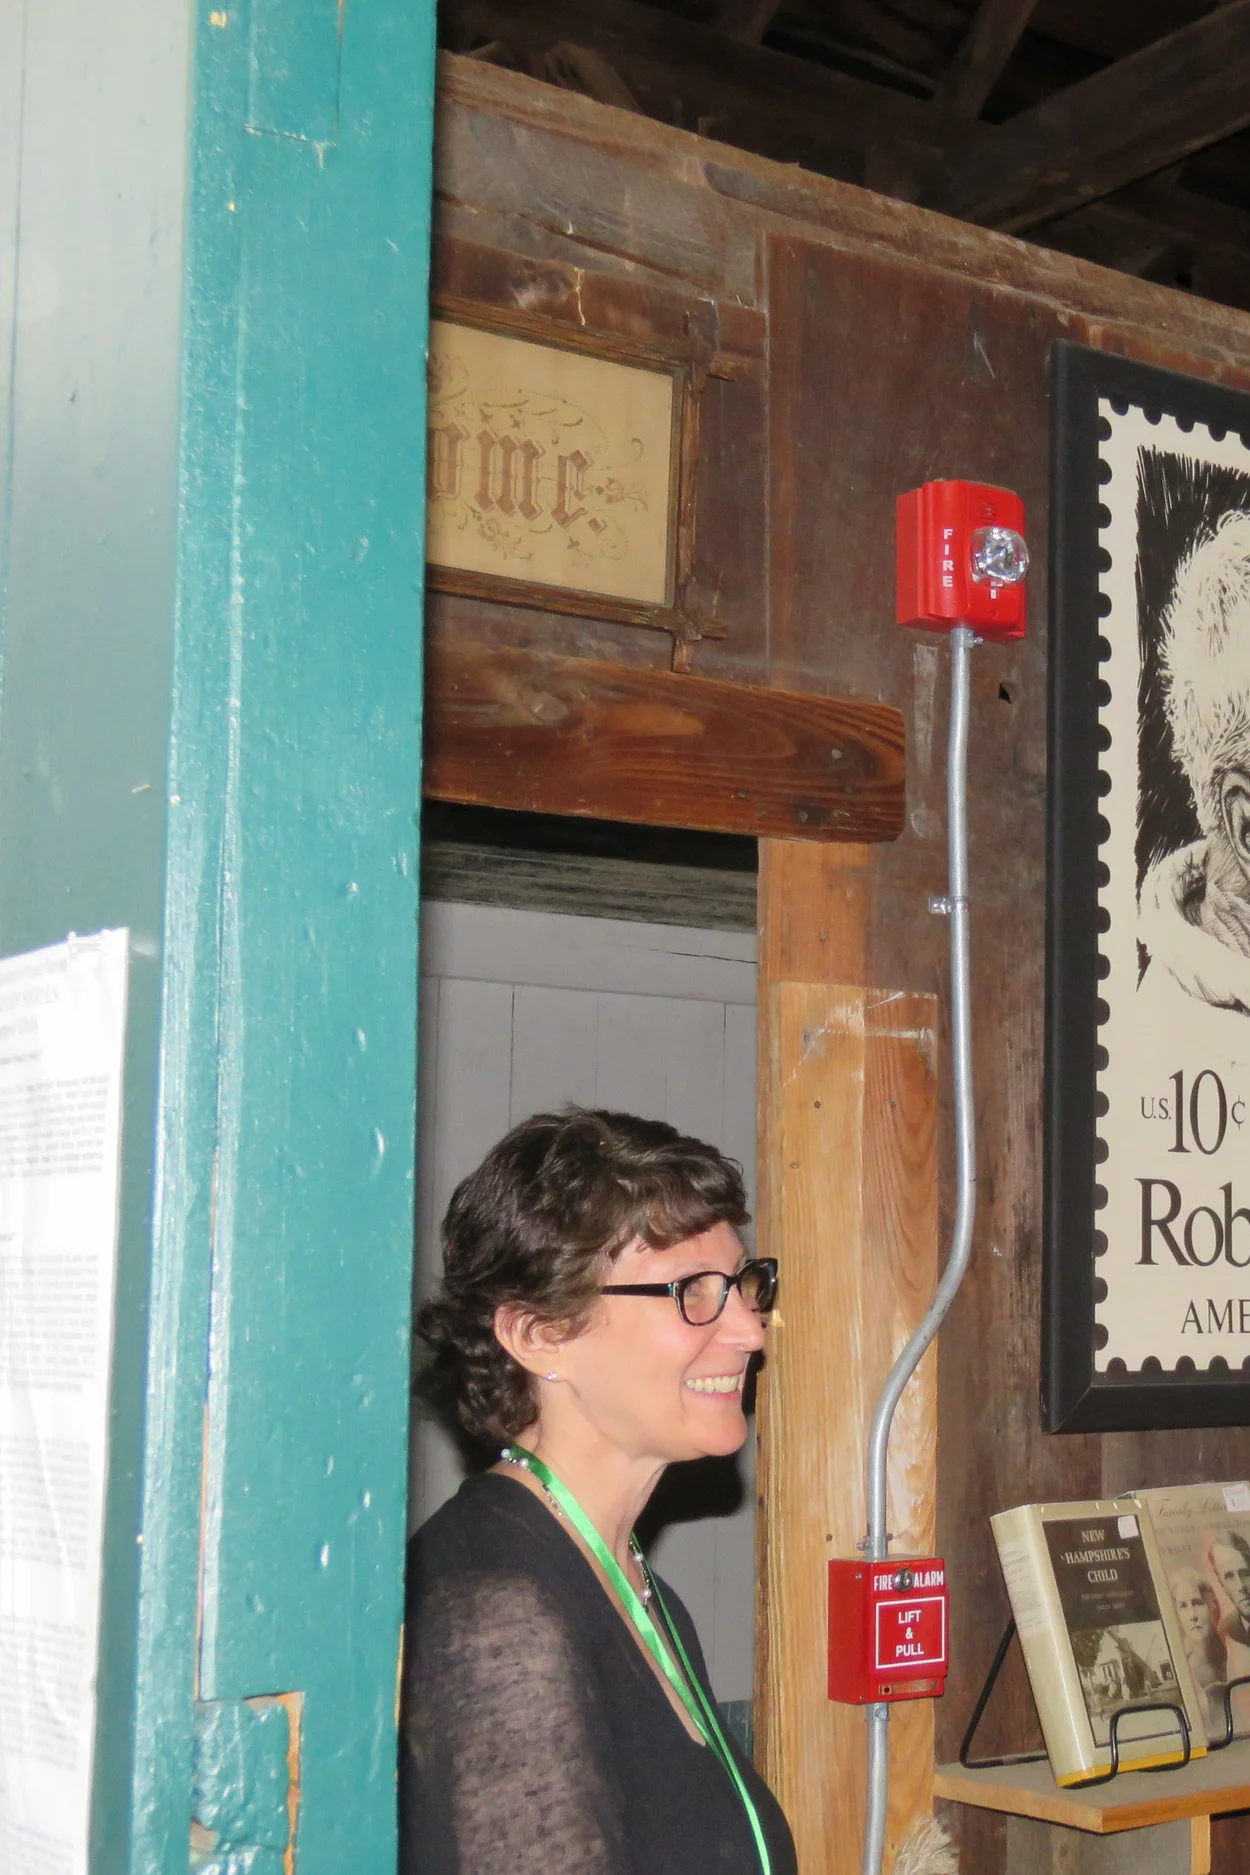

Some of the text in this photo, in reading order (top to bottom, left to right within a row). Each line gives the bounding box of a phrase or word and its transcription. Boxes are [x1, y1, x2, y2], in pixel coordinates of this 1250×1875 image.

[428, 422, 607, 533] ome.
[943, 528, 954, 588] FIRE
[1081, 1529, 1105, 1543] NEW
[1065, 1547, 1131, 1564] HAMPSHIRE'S
[873, 1570, 944, 1592] FIRE ALARM
[1087, 1568, 1118, 1583] CHILD
[898, 1610, 921, 1625] LIFT
[905, 1626, 914, 1640] &
[895, 1643, 925, 1658] PULL
